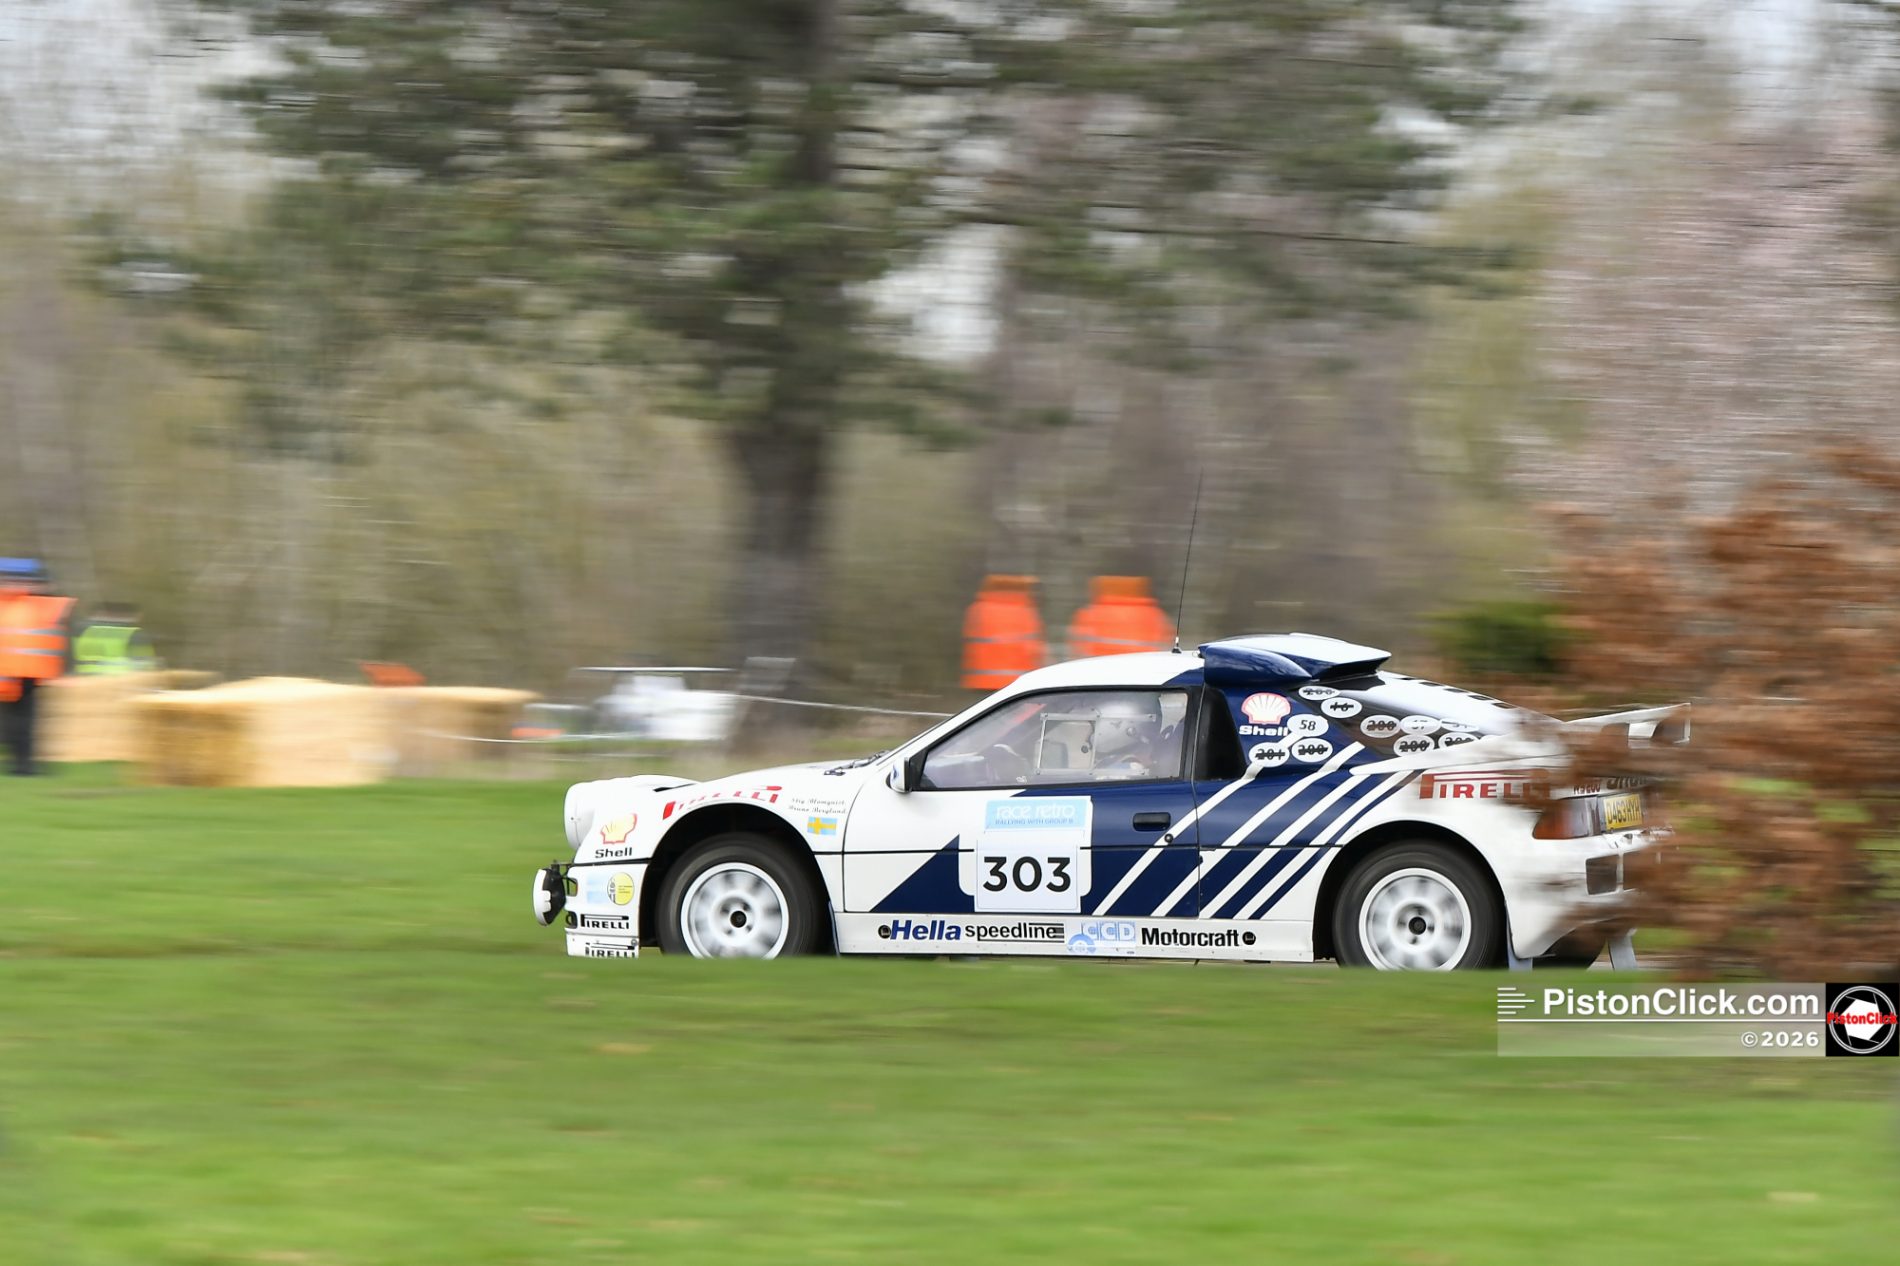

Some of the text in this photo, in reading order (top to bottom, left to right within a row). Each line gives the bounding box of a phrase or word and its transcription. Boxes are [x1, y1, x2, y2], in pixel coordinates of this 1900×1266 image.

[1239, 725, 1289, 737] Shell
[1299, 719, 1317, 731] 58
[996, 803, 1076, 818] race retro
[595, 847, 633, 858] Shell
[983, 856, 1071, 892] 303
[581, 914, 630, 930] PIRELLI
[890, 919, 961, 940] Hella
[1082, 921, 1136, 940] CCD
[965, 922, 1064, 943] speedline
[1141, 928, 1240, 947] Motorcraft
